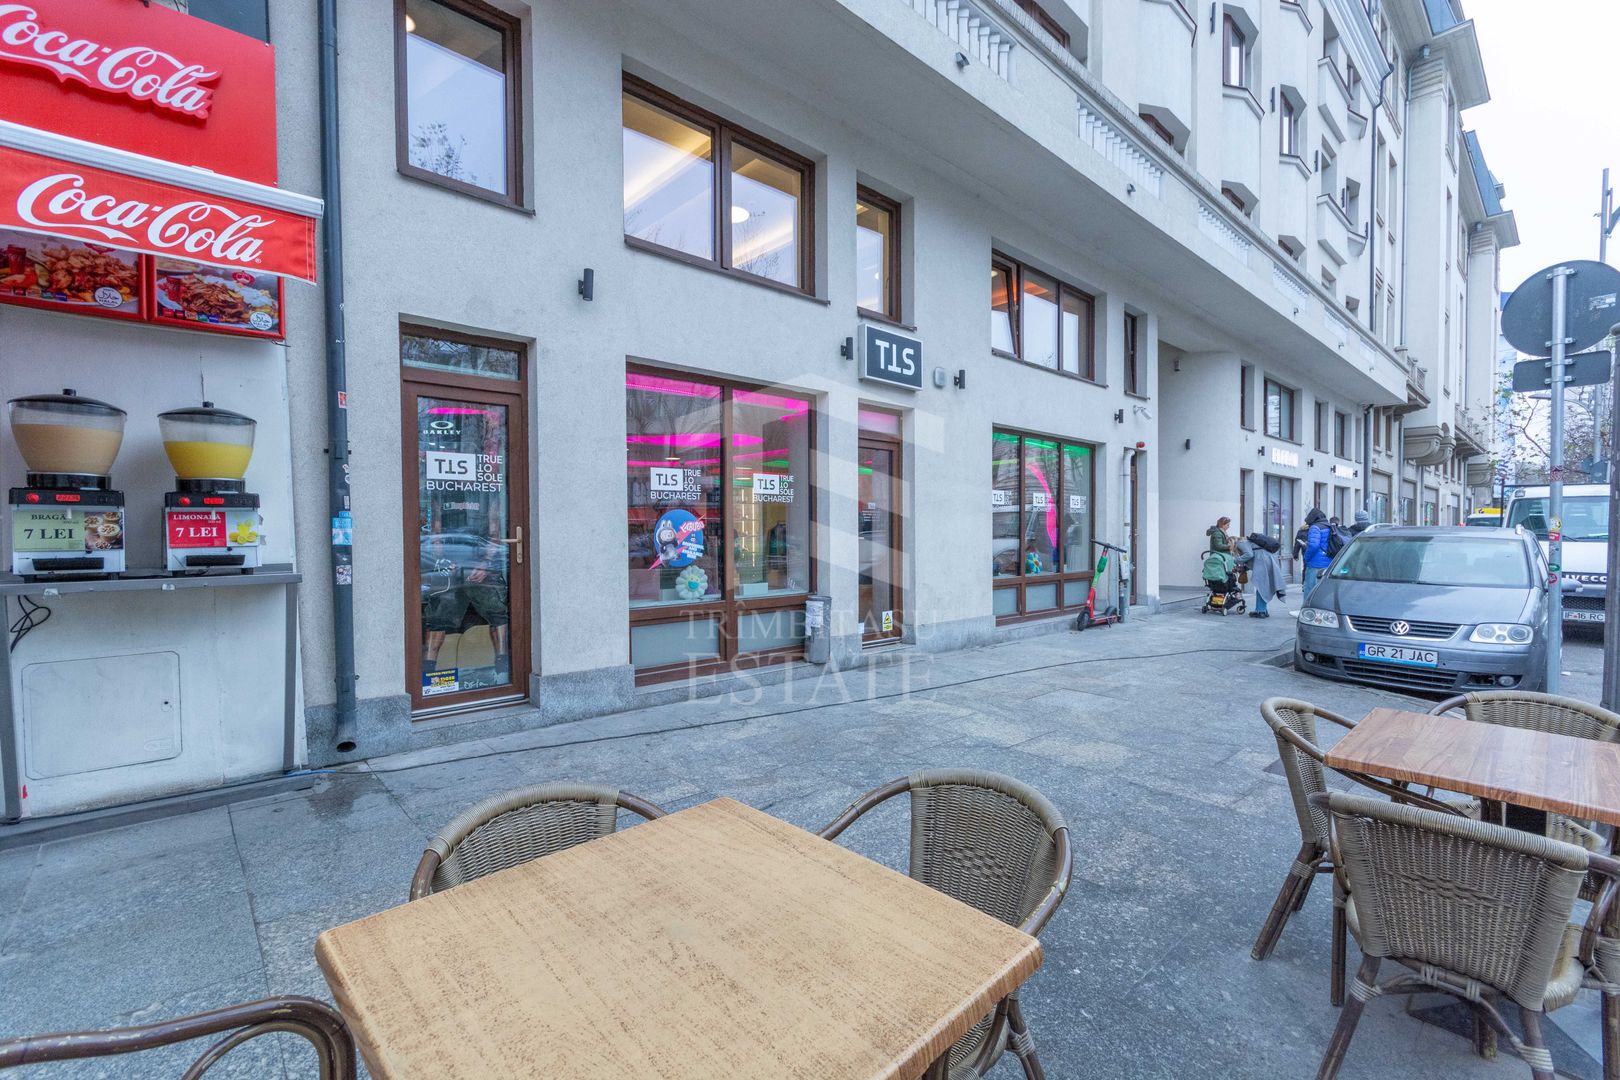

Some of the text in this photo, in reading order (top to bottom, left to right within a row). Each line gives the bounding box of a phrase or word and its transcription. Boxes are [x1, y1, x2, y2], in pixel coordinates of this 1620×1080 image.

[17, 173, 275, 262] Coca-Cola
[477, 454, 503, 464] TRUE
[477, 473, 503, 482] SOLE
[684, 469, 702, 477] TRUE
[426, 481, 504, 492] BUCHAREST
[684, 484, 702, 492] SOLE
[650, 491, 702, 500] BUCHAREST
[779, 488, 794, 496] SOLE
[753, 495, 794, 503] BUCHAREST
[31, 512, 66, 520] BRAGĂ
[24, 528, 74, 540] 7 LEI
[175, 527, 218, 538] 7 LEI
[1577, 612, 1586, 620] 16
[1590, 613, 1604, 621] RC
[1367, 646, 1434, 662] GR 21 JAC
